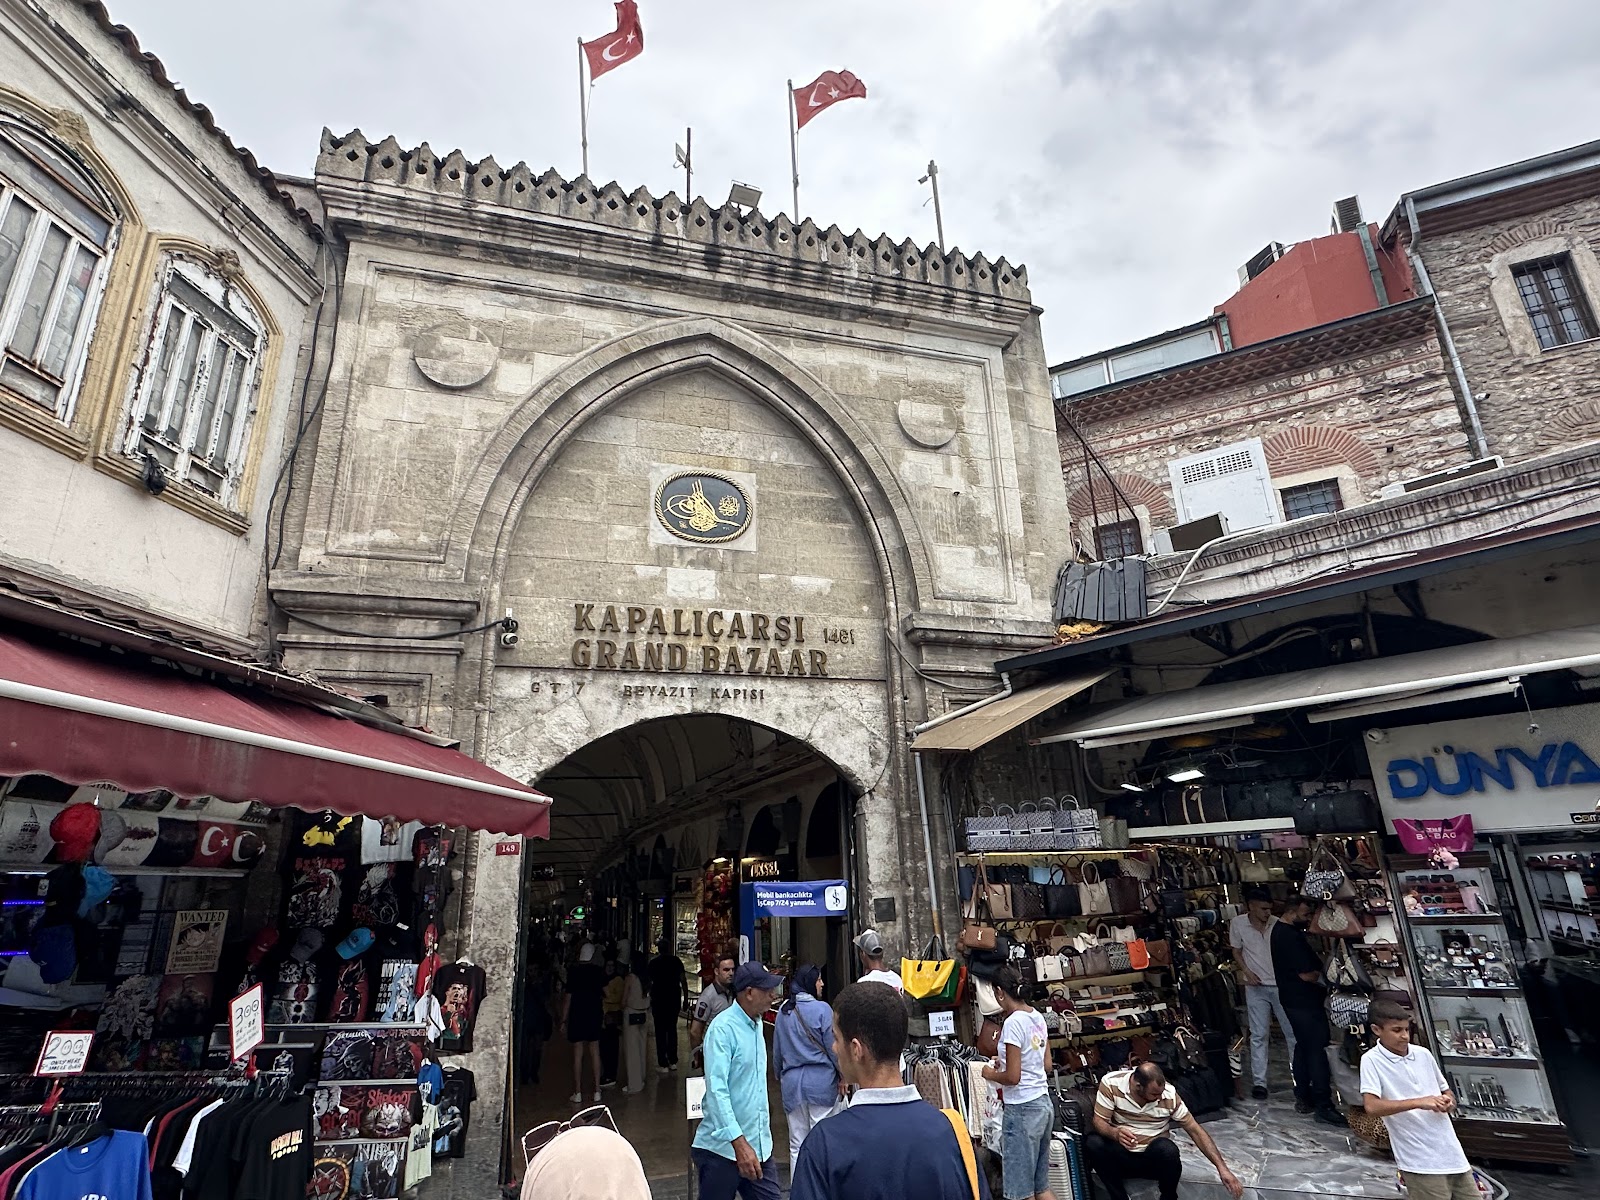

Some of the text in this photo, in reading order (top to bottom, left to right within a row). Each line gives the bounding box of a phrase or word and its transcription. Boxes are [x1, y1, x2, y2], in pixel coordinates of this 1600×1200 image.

[574, 603, 805, 646] KAPALIÇARŞI
[571, 638, 828, 676] GRAND BAZAAR
[622, 684, 765, 701] BEYAZIT KAPISI
[1387, 741, 1600, 799] DÜNYA
[501, 844, 516, 853] 149
[756, 891, 775, 899] Mobil
[181, 911, 225, 922] WANTED
[235, 999, 259, 1028] 300
[44, 1036, 84, 1060] 200
